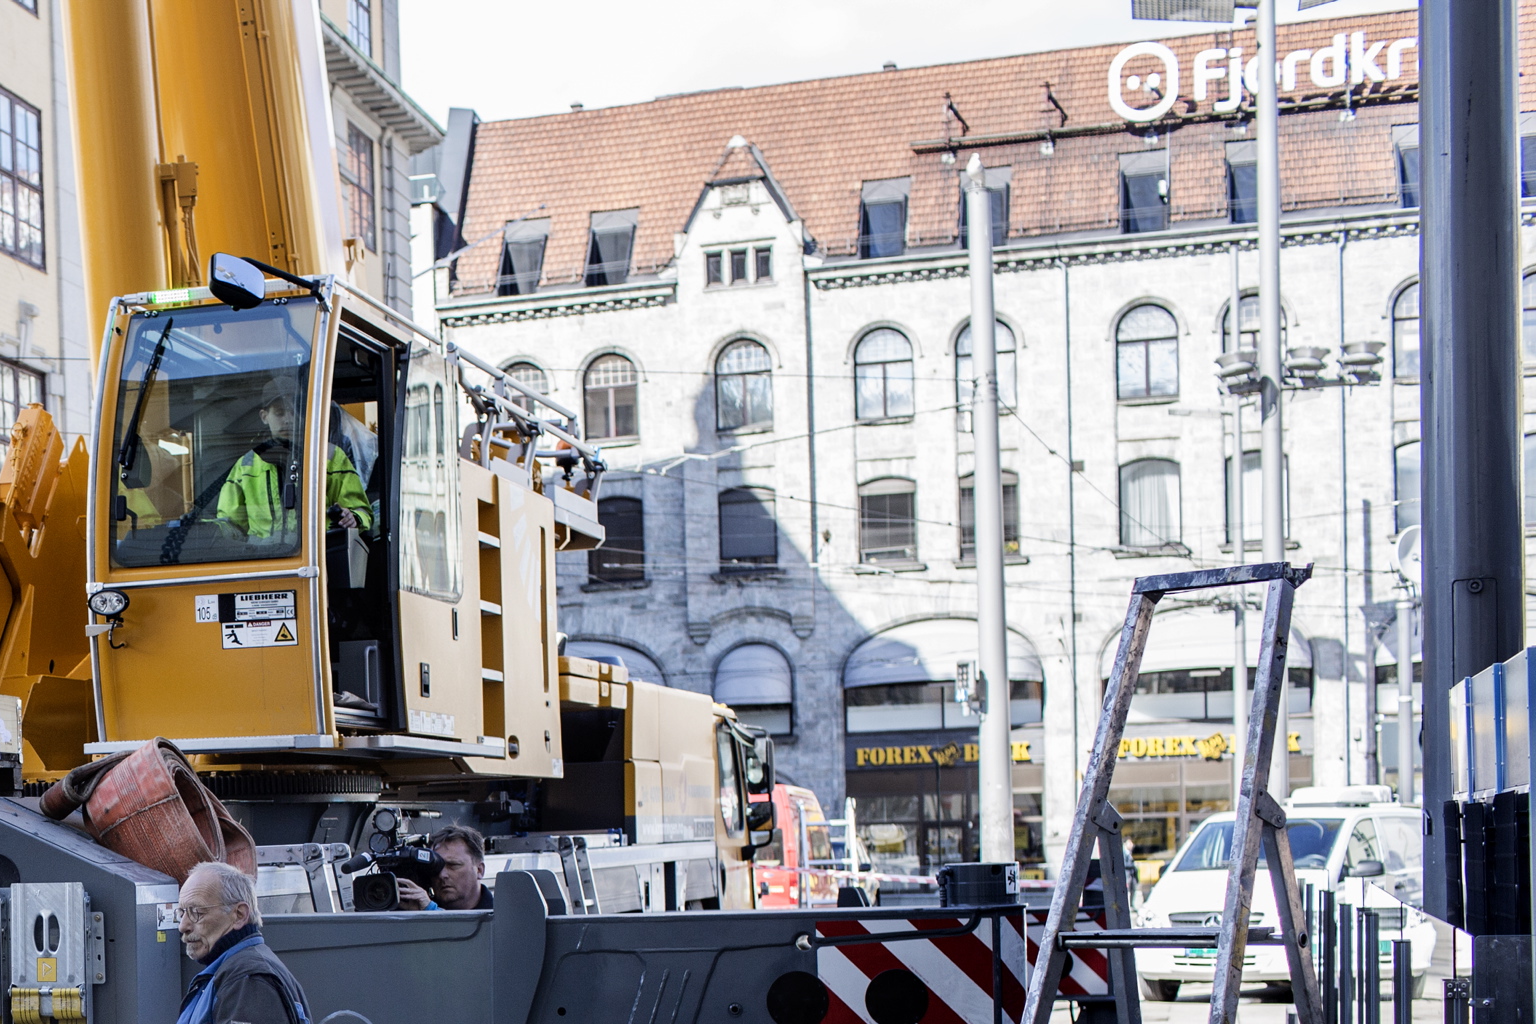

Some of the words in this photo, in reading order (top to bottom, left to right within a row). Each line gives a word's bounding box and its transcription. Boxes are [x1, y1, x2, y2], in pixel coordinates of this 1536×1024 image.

[240, 593, 288, 601] LIEBHERR
[197, 606, 210, 620] 105
[856, 745, 934, 767] FOREX
[964, 741, 1031, 762] BK
[1117, 735, 1197, 757] FOREX
